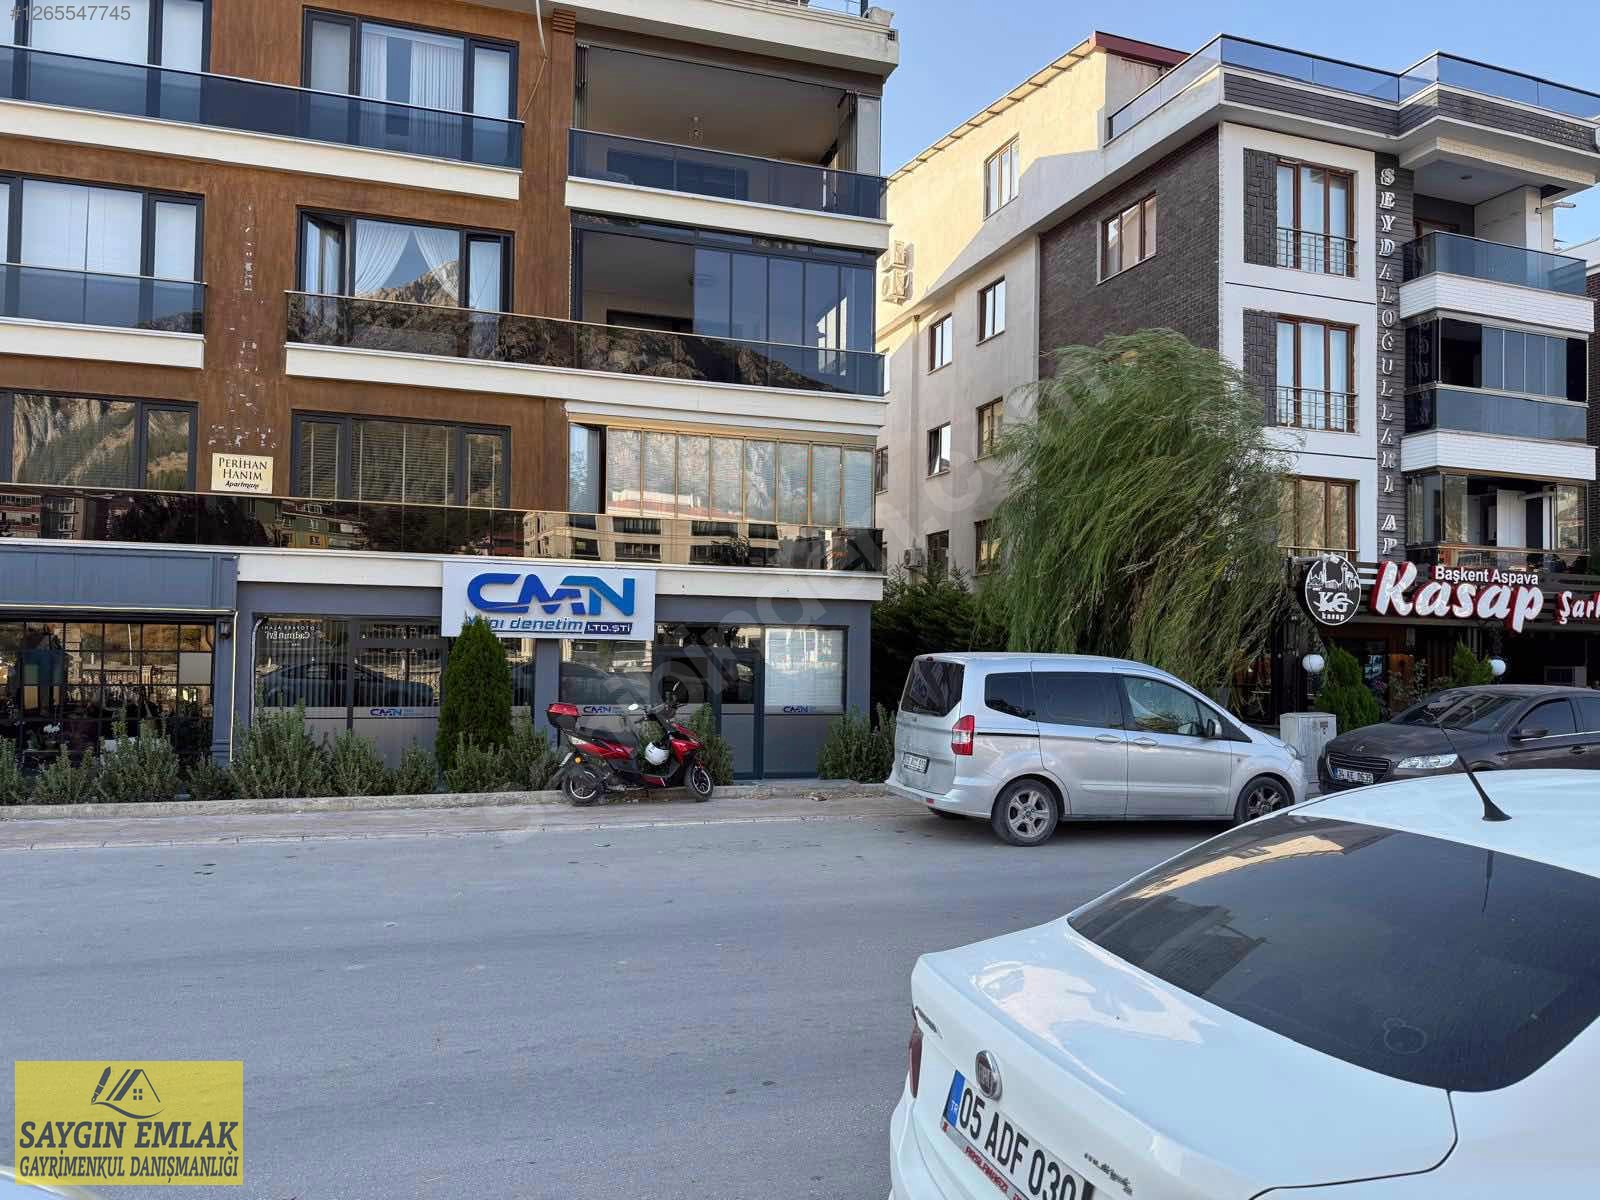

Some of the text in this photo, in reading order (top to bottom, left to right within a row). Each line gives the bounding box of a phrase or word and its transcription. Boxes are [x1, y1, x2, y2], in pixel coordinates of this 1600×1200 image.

[218, 457, 267, 470] PERİHAN
[223, 468, 263, 481] HANIM
[1381, 514, 1398, 555] AP
[1435, 566, 1539, 586] Başkent Aspava
[1375, 560, 1544, 633] Kasap
[510, 616, 583, 631] denetim
[960, 1087, 986, 1140] 05
[984, 1111, 1030, 1174] ADF
[1028, 1149, 1077, 1200] 030
